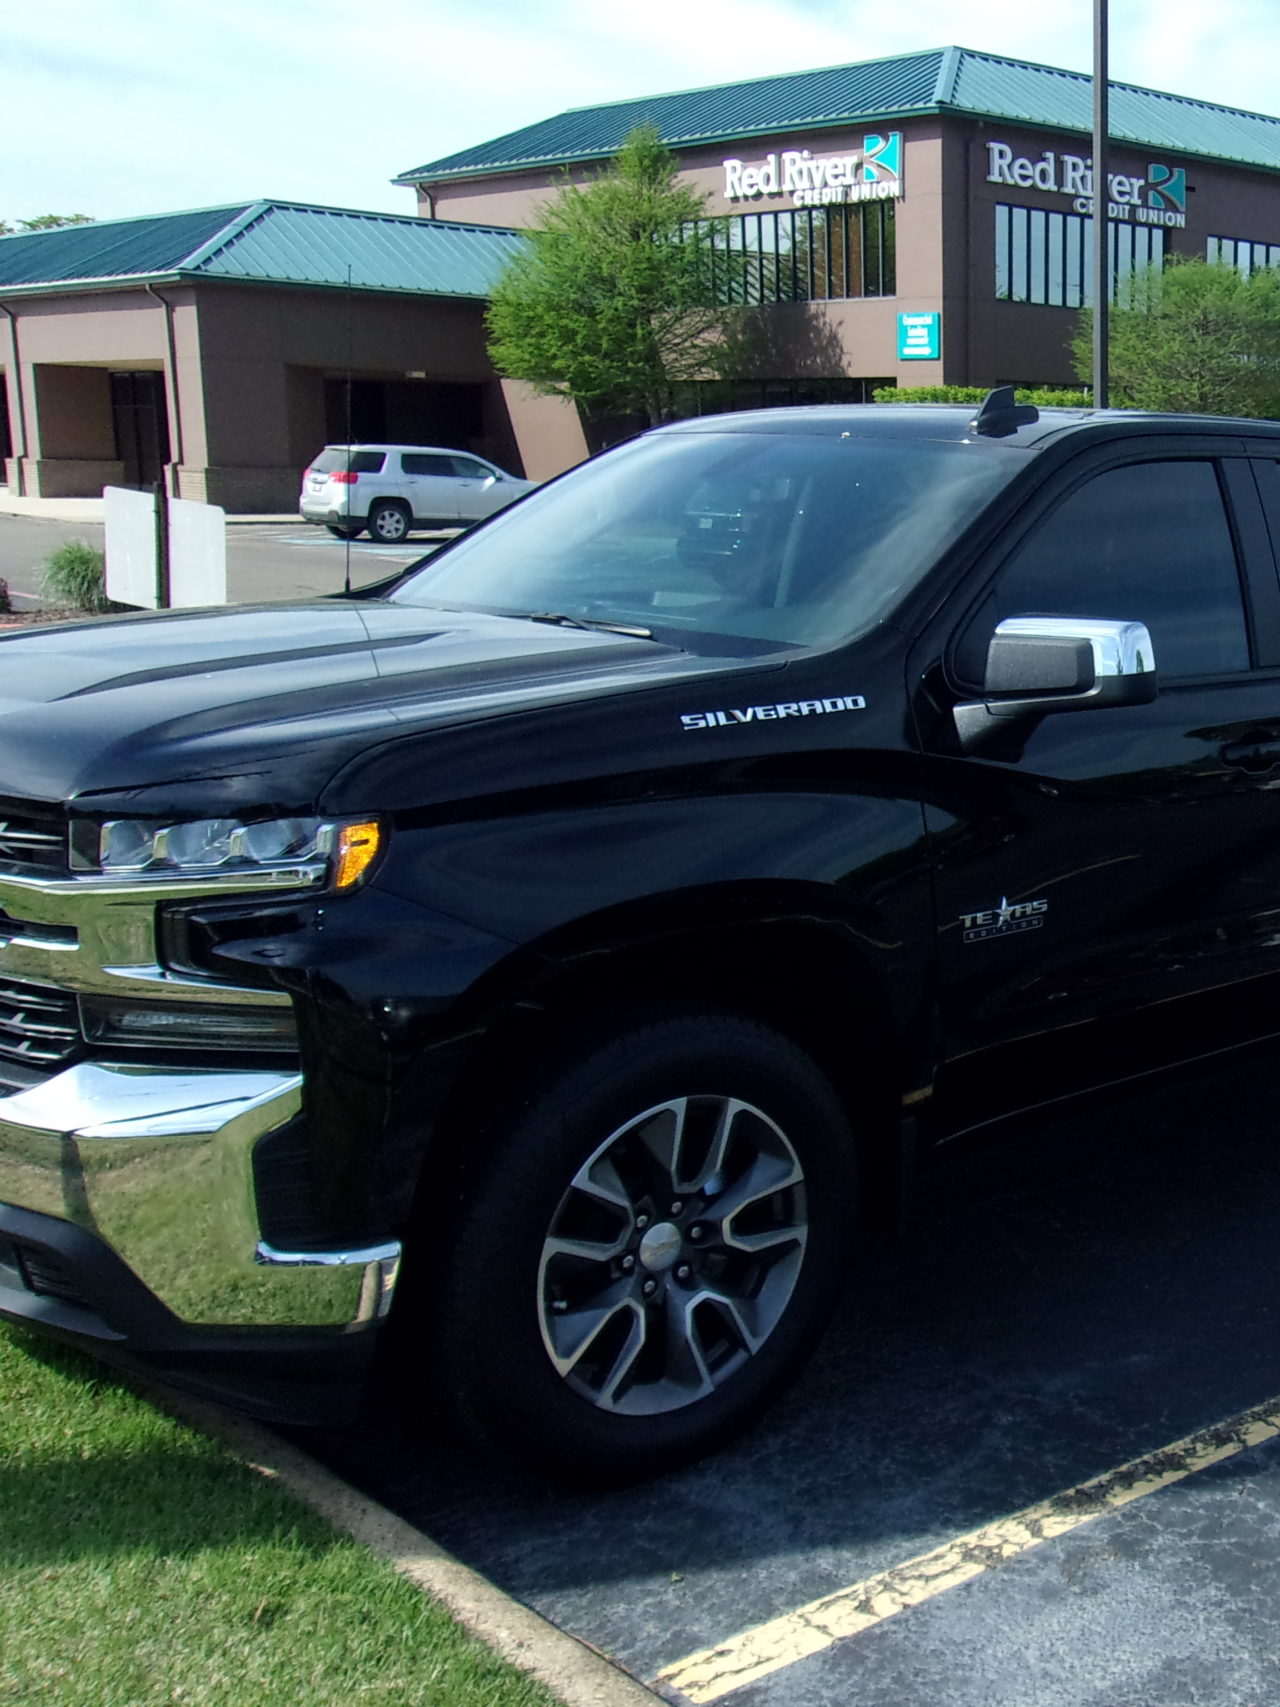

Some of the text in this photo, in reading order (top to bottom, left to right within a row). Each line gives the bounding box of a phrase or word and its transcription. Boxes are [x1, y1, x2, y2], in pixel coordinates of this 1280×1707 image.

[723, 150, 859, 198] Red River
[985, 141, 1058, 192] Red
[793, 179, 901, 206] CREDIT UNION
[1073, 197, 1186, 228] CDIT UNION
[680, 695, 866, 731] SILVERADO
[969, 919, 1039, 939] EDITION
